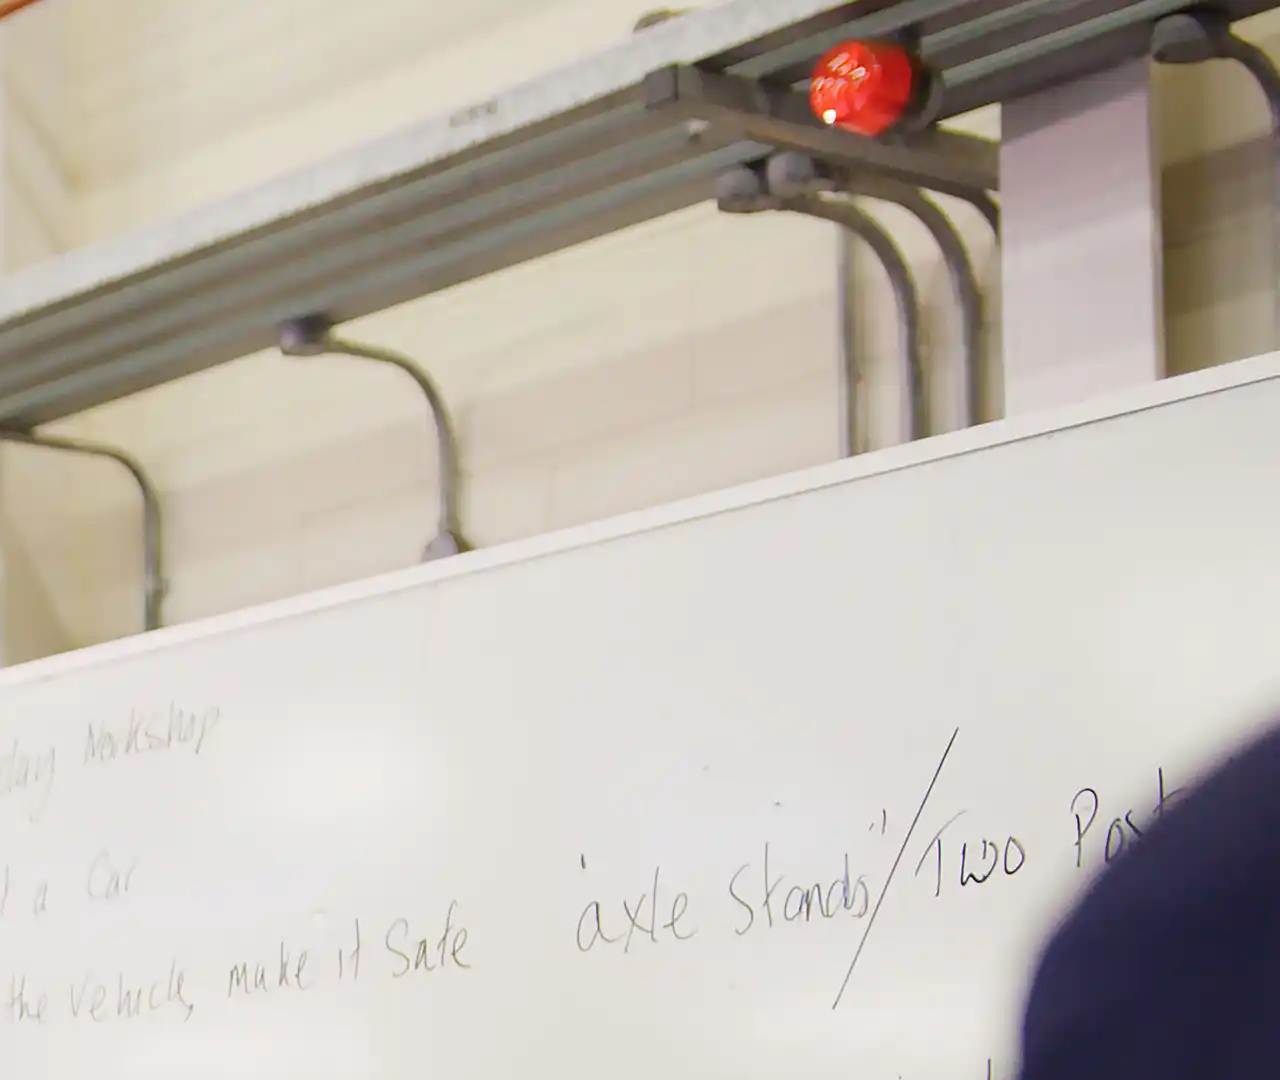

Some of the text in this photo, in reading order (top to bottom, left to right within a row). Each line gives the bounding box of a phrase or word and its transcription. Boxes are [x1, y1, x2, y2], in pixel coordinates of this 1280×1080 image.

[33, 881, 49, 918] a
[87, 846, 140, 900] Car
[4, 973, 47, 1026] the
[227, 939, 311, 998] make
[339, 918, 360, 981] it
